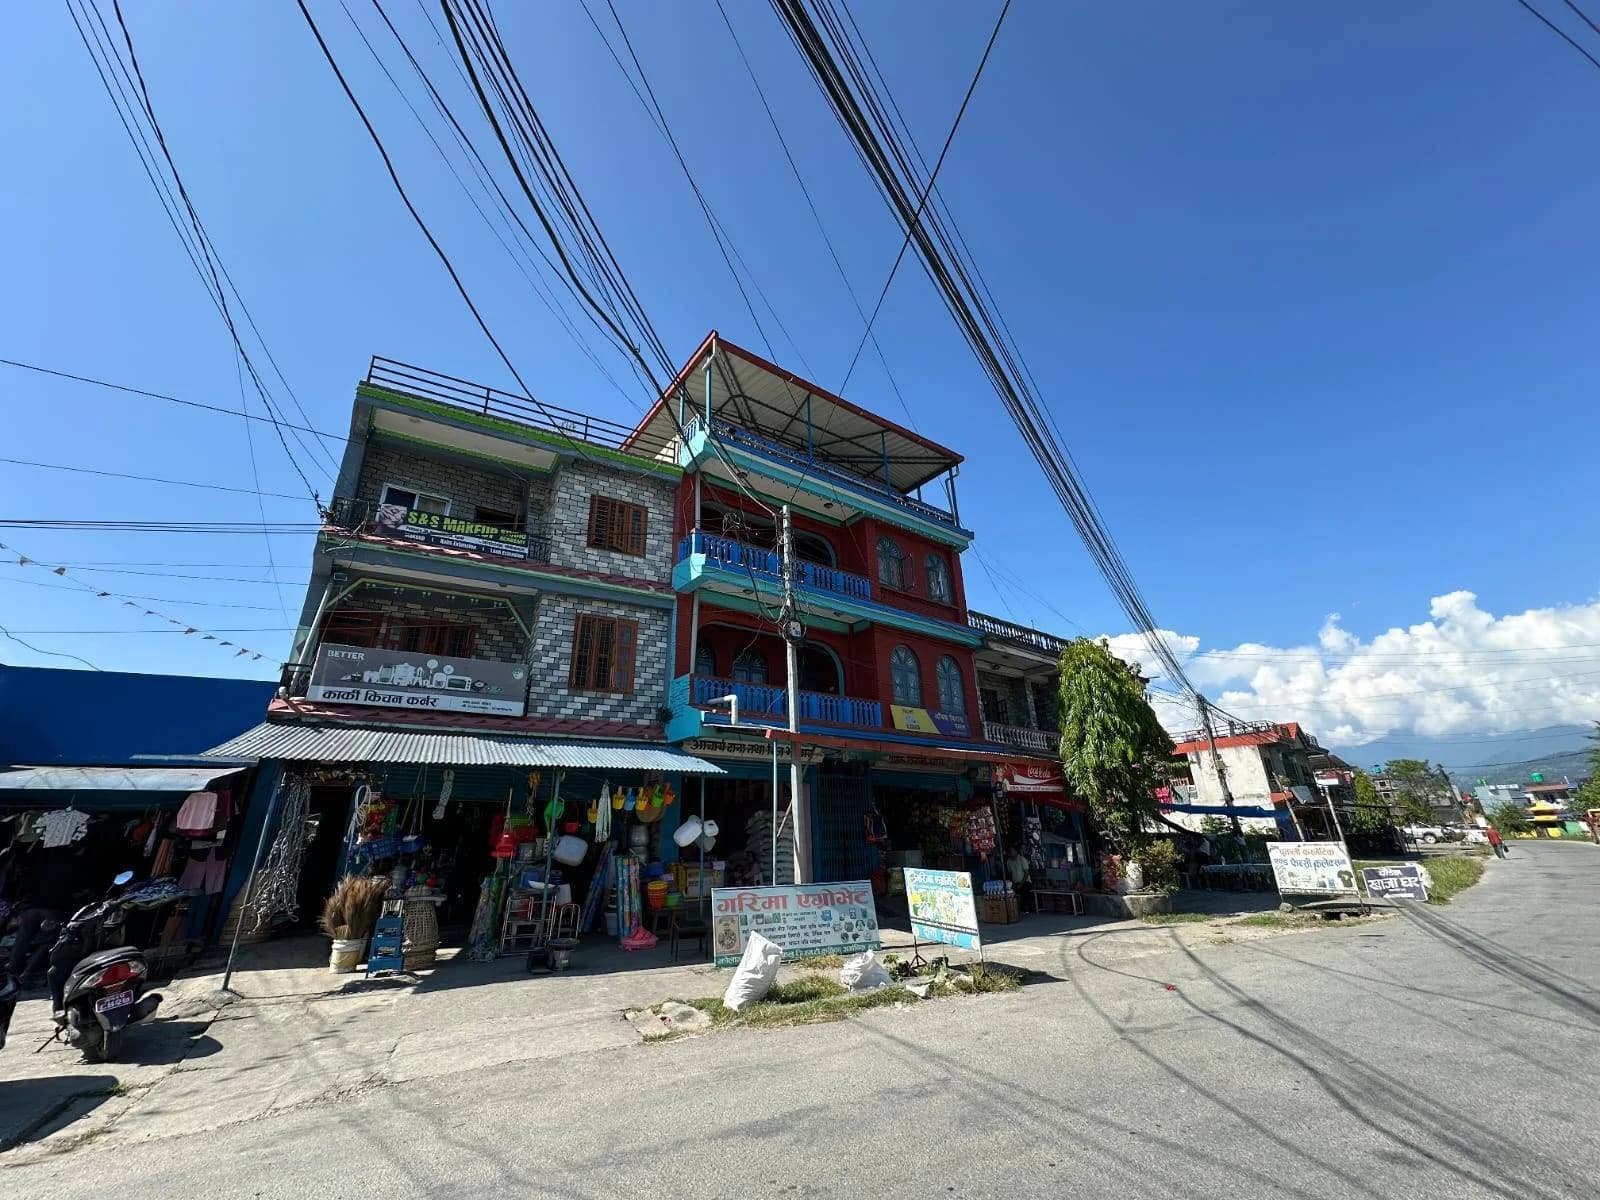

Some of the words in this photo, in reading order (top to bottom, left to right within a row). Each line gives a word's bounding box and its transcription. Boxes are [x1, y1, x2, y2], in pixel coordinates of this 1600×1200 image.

[407, 511, 440, 526] S&S
[328, 650, 365, 661] BETTER
[322, 689, 361, 702] कार्की
[364, 691, 403, 705] किचन
[406, 694, 440, 707] कर्नर
[690, 739, 725, 753] आचार्य
[1368, 878, 1399, 890] खाजा
[1399, 876, 1420, 888] घर
[717, 892, 789, 913] गरिमा
[796, 887, 870, 909] एग्रोभेट
